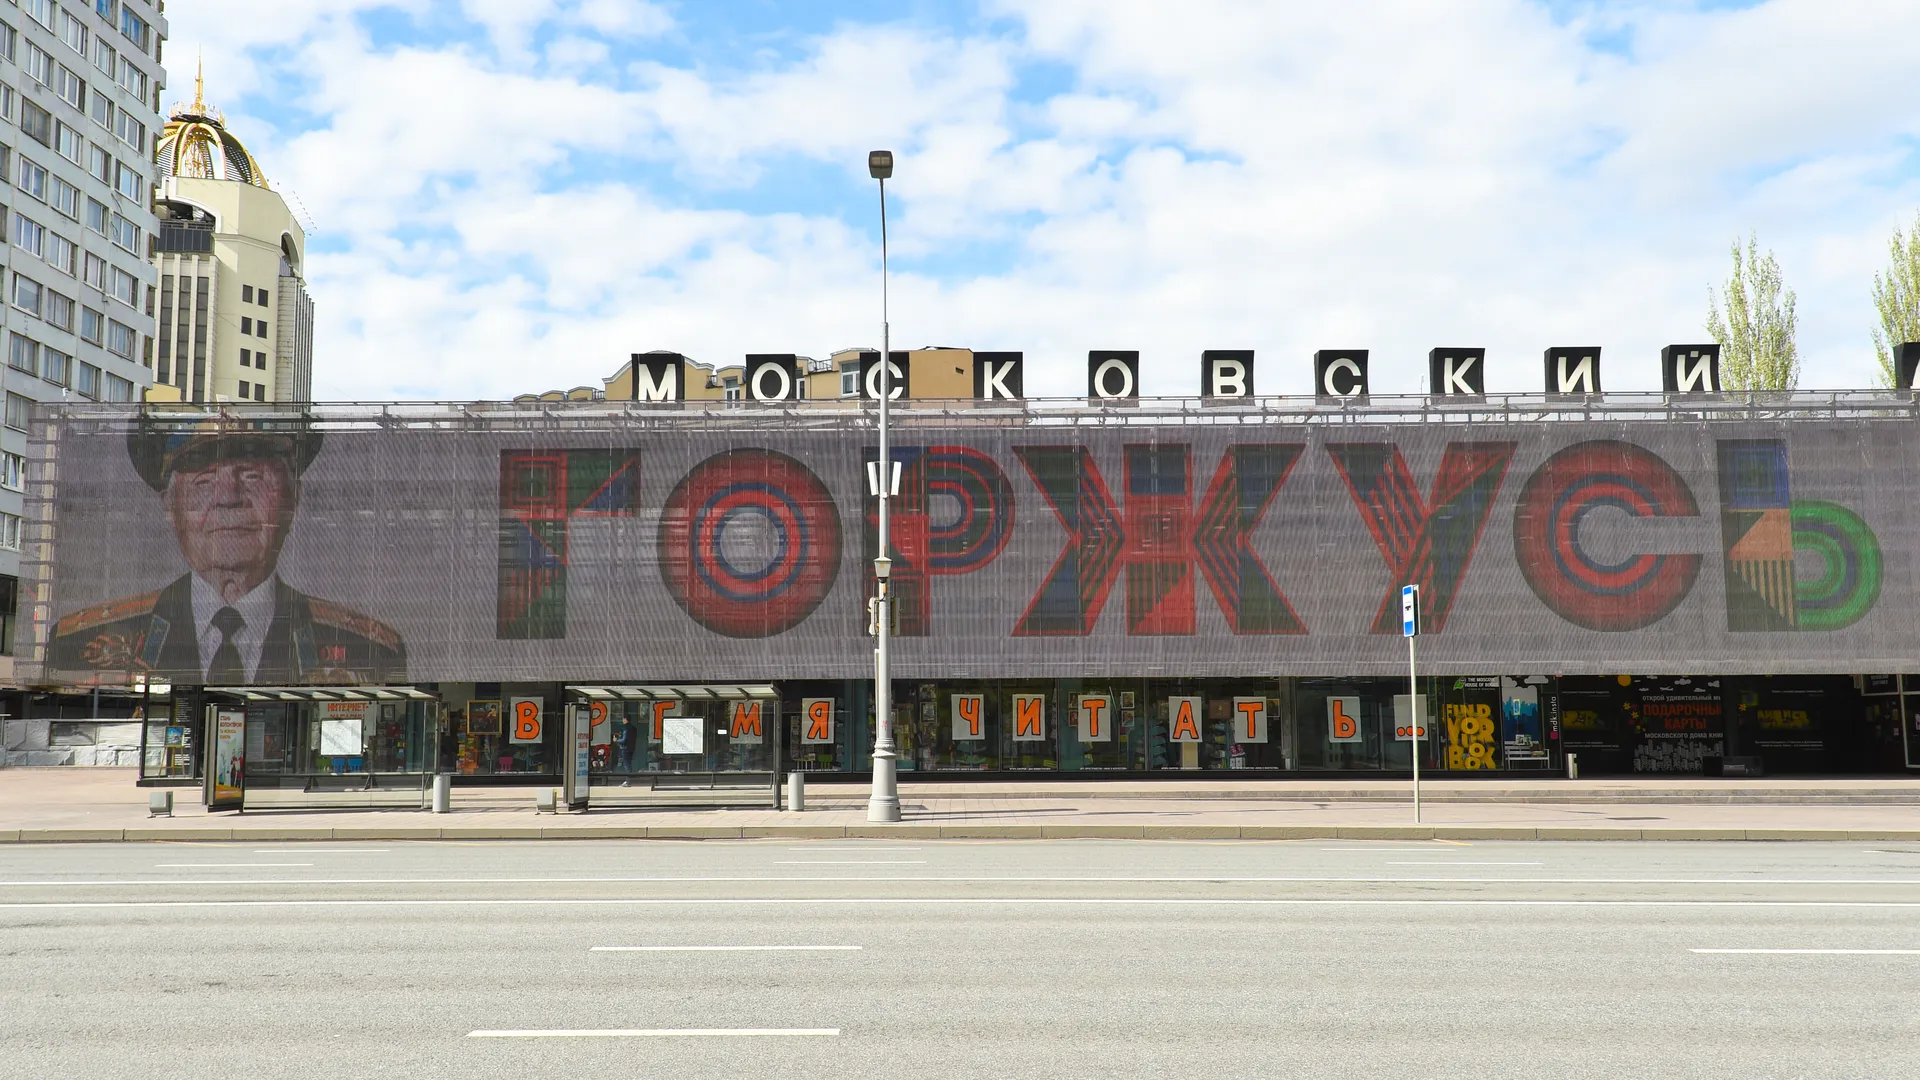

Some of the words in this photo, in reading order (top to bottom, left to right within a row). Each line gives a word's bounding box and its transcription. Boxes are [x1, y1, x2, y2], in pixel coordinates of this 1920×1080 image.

[638, 350, 1715, 403] МОСКОВСКИЙ
[496, 439, 1885, 638] ГОРЖУСЬ
[1550, 696, 1558, 732] mdk.insta
